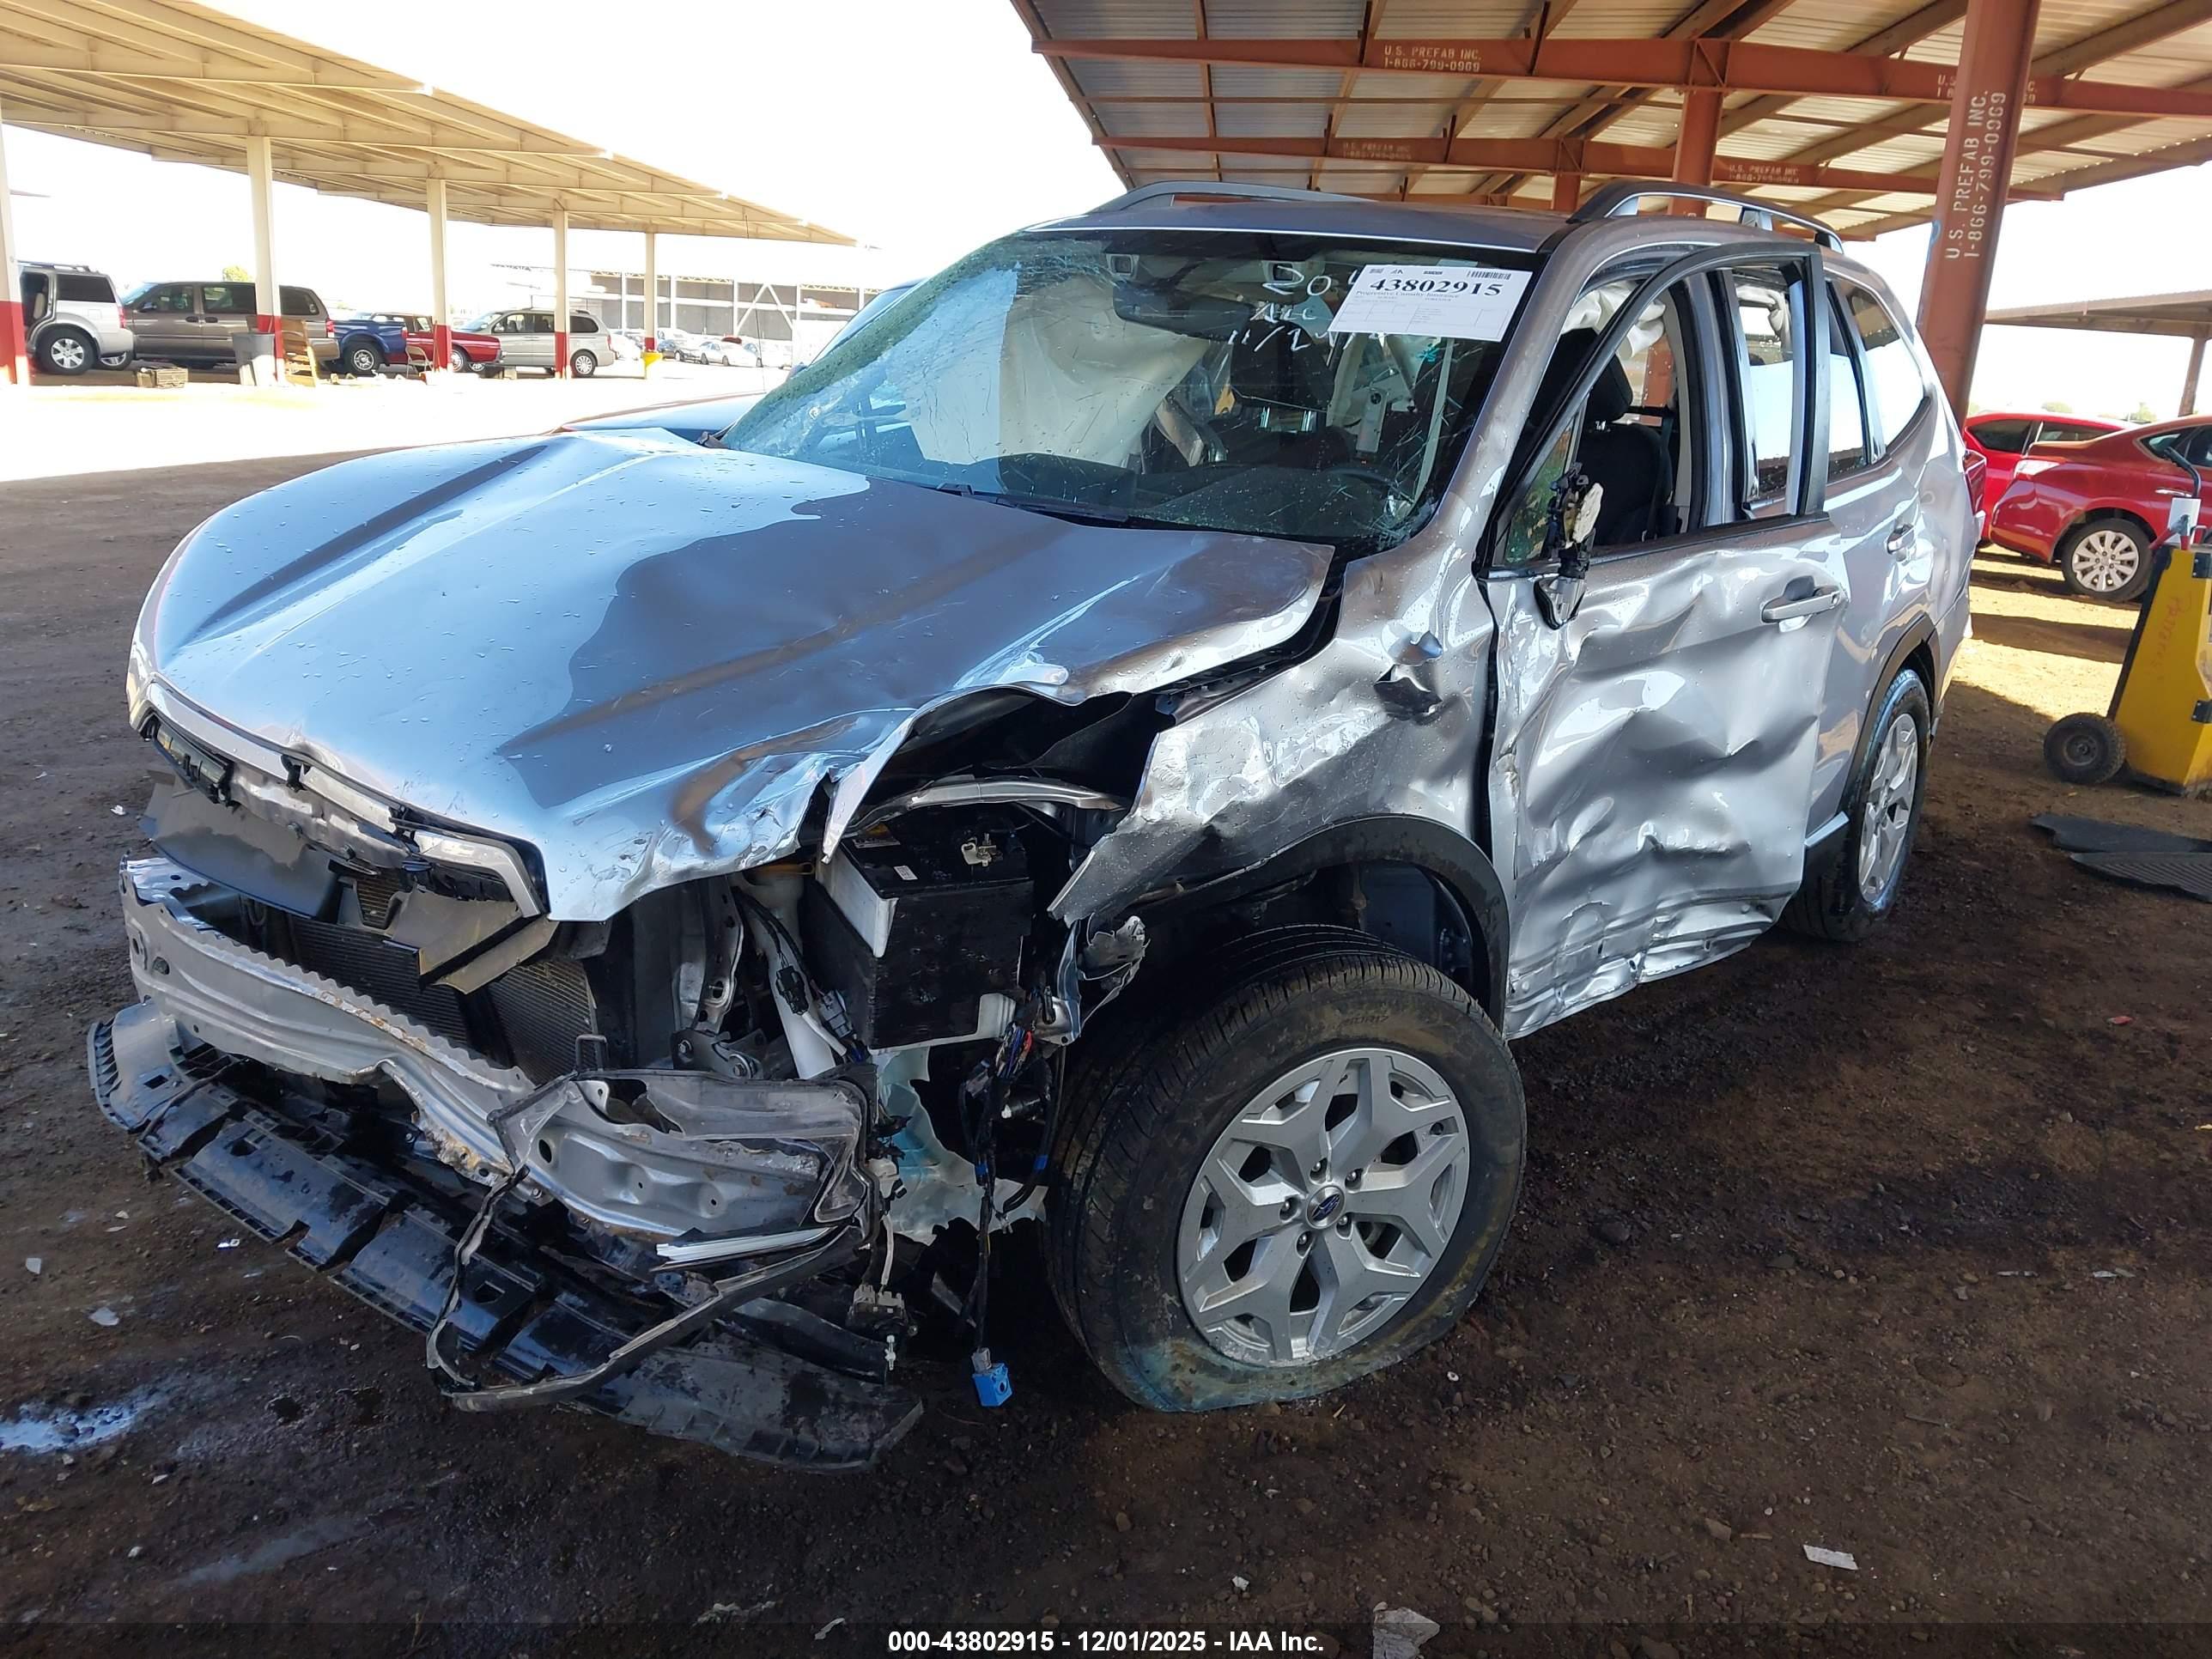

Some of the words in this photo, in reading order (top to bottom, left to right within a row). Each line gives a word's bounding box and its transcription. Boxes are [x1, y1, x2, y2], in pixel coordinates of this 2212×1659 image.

[1411, 46, 1455, 58] PREFAB
[1460, 48, 1482, 61] INC.
[1967, 90, 1989, 127] INC.
[1953, 137, 1979, 212] PREFAB
[1963, 92, 2007, 258] 1-866-799-0969
[1946, 223, 1965, 259] U.S.
[1370, 278, 1504, 296] 43802915
